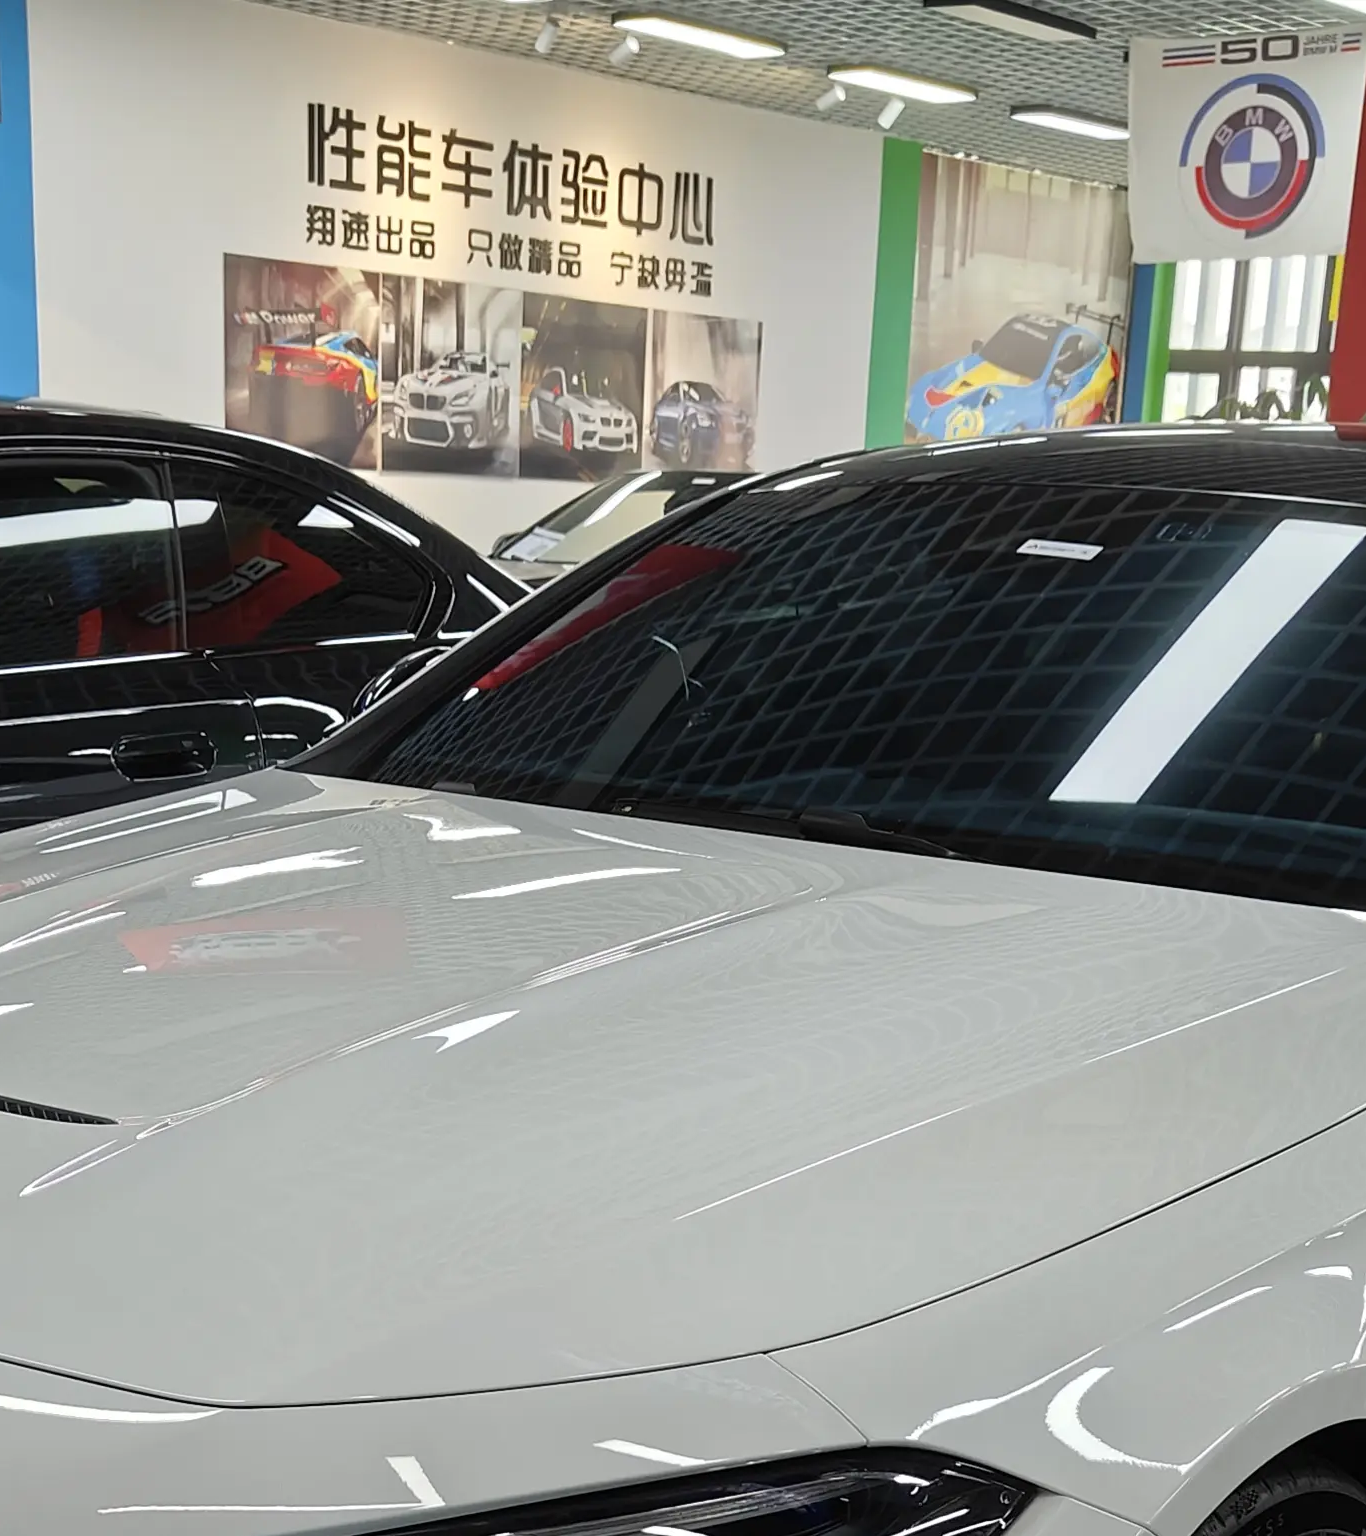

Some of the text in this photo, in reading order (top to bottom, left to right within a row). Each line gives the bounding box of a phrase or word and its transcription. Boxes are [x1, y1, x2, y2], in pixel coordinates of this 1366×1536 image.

[1220, 35, 1299, 64] 50
[1214, 108, 1294, 147] BMW
[307, 102, 714, 247] 性能车体验中心
[306, 204, 435, 260] 翔速出品
[466, 228, 582, 279] 只做精品
